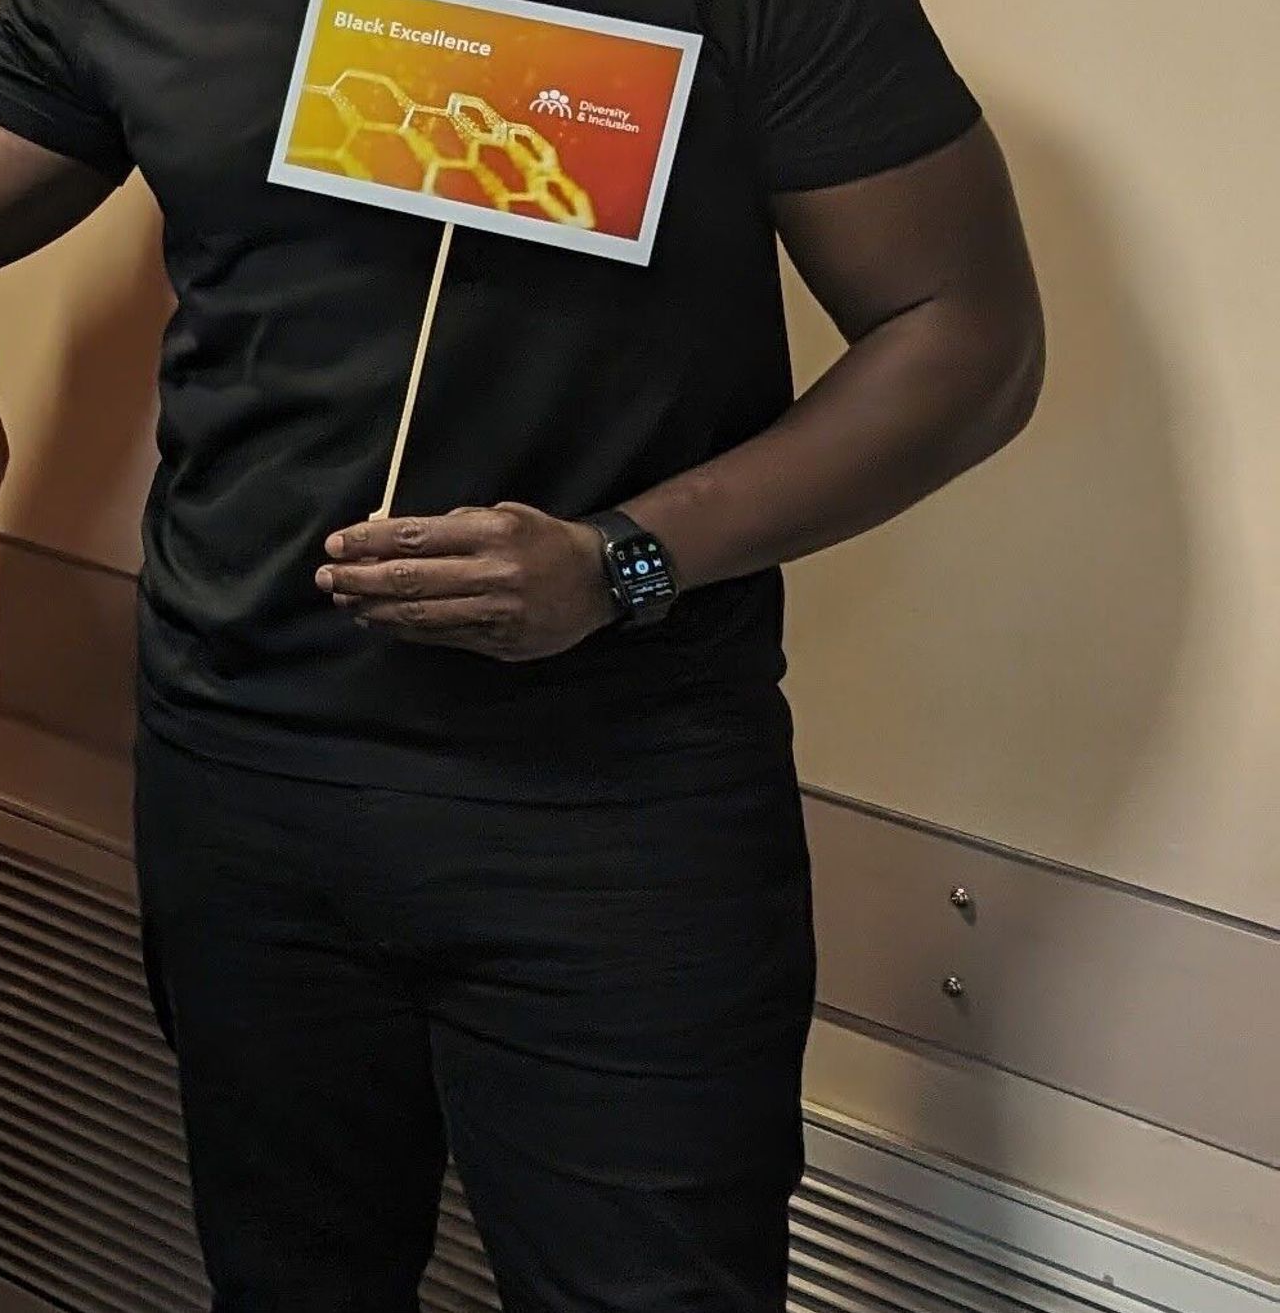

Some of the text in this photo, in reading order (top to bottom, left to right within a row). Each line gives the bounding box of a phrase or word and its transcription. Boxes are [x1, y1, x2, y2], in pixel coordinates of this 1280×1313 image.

[334, 10, 492, 57] Black Excellence
[579, 99, 630, 121] Diversity
[576, 111, 640, 134] & Inclusion
